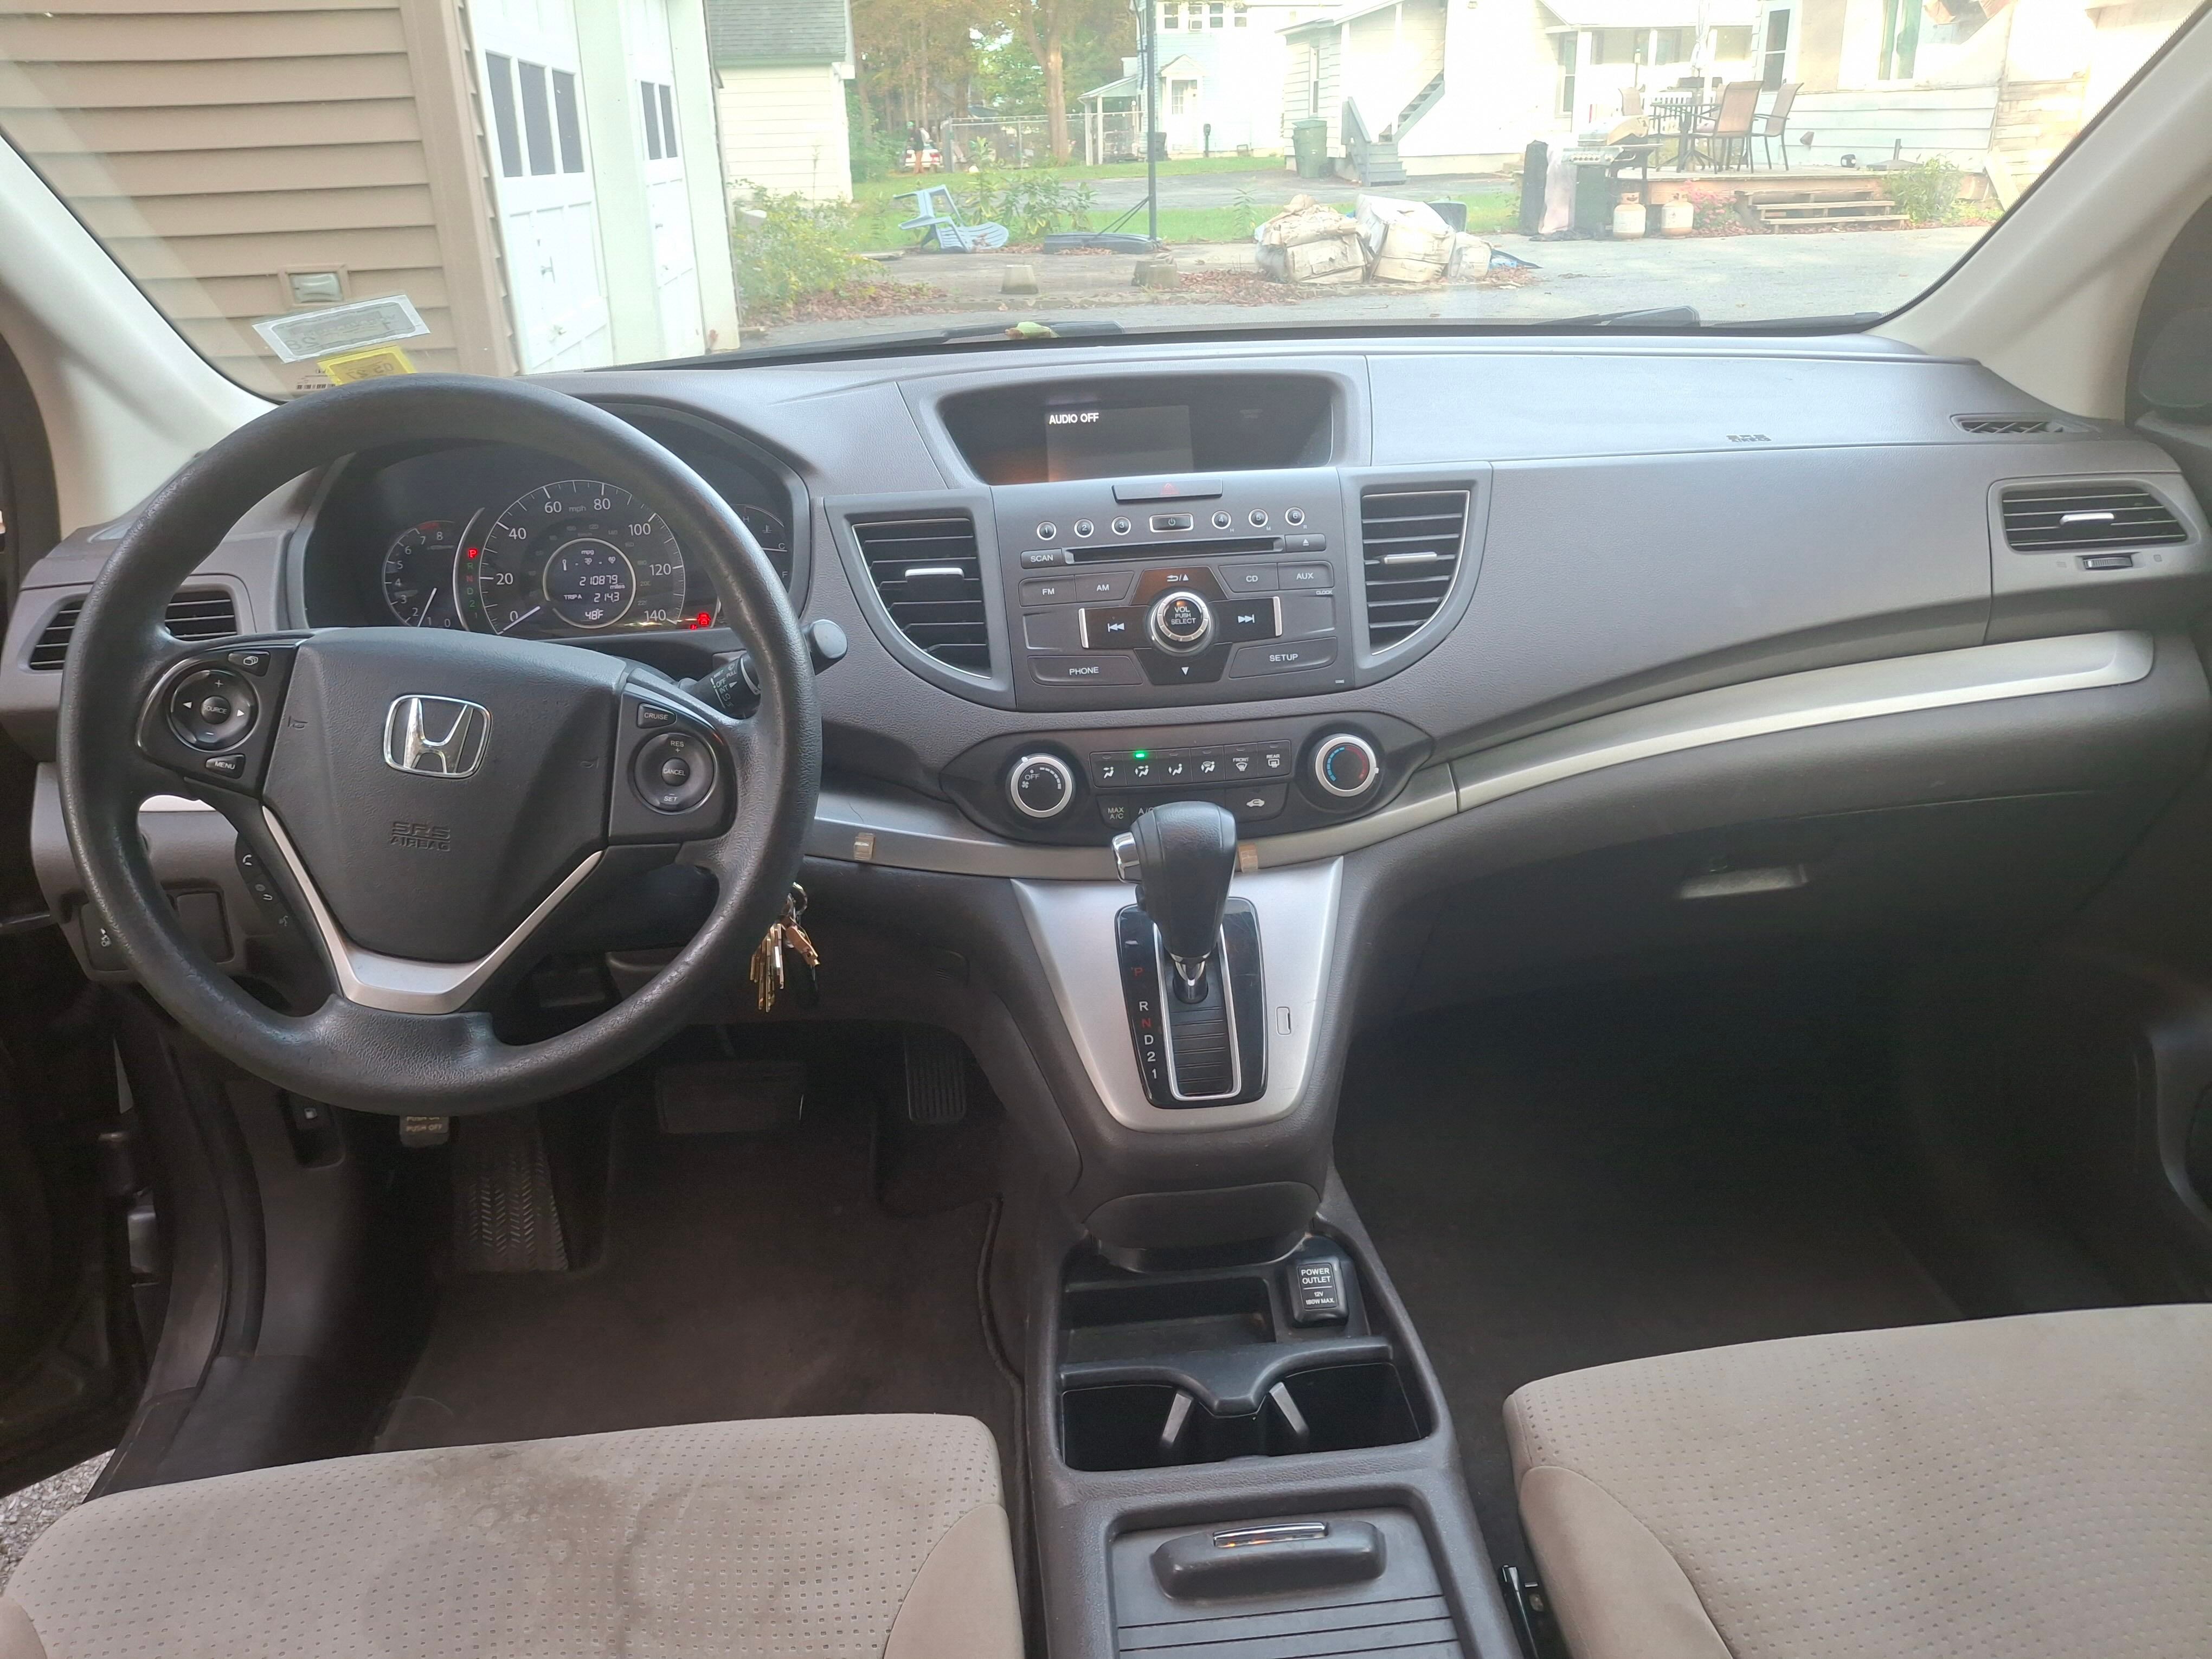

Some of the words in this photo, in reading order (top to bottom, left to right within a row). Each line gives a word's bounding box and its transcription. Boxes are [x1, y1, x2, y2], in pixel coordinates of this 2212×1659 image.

[1049, 414, 1078, 425] AUDIO
[1080, 413, 1099, 422] OFF
[544, 501, 562, 513] 60
[594, 498, 611, 510] 80
[509, 528, 526, 540] 40
[628, 523, 651, 536] 100
[420, 536, 426, 545] 7
[436, 532, 443, 541] 8
[405, 546, 411, 555] 6
[468, 549, 477, 558] P
[397, 561, 403, 569] 5
[649, 563, 671, 576] 120
[496, 573, 513, 585] 20
[580, 575, 618, 586] 210879
[401, 595, 407, 603] 3
[412, 608, 419, 616] 2
[510, 610, 518, 622] 0
[645, 609, 666, 622] 140
[427, 617, 432, 625] 1
[445, 619, 451, 627] 0
[1269, 653, 1298, 662] SETUP
[1069, 666, 1099, 676] PHONE
[716, 677, 726, 687] OFF
[719, 685, 729, 694] INT
[722, 693, 731, 701] LO
[203, 705, 227, 715] SOURCE
[644, 712, 668, 721] CRUISE
[215, 761, 235, 769] MENU
[663, 768, 686, 776] CANCEL
[1134, 967, 1144, 976] P
[1139, 1001, 1149, 1011] R
[1141, 1018, 1152, 1028] N
[1144, 1035, 1154, 1045] D
[1147, 1052, 1156, 1062] 2
[1152, 1069, 1158, 1079] 1
[1301, 1268, 1330, 1276] POWER
